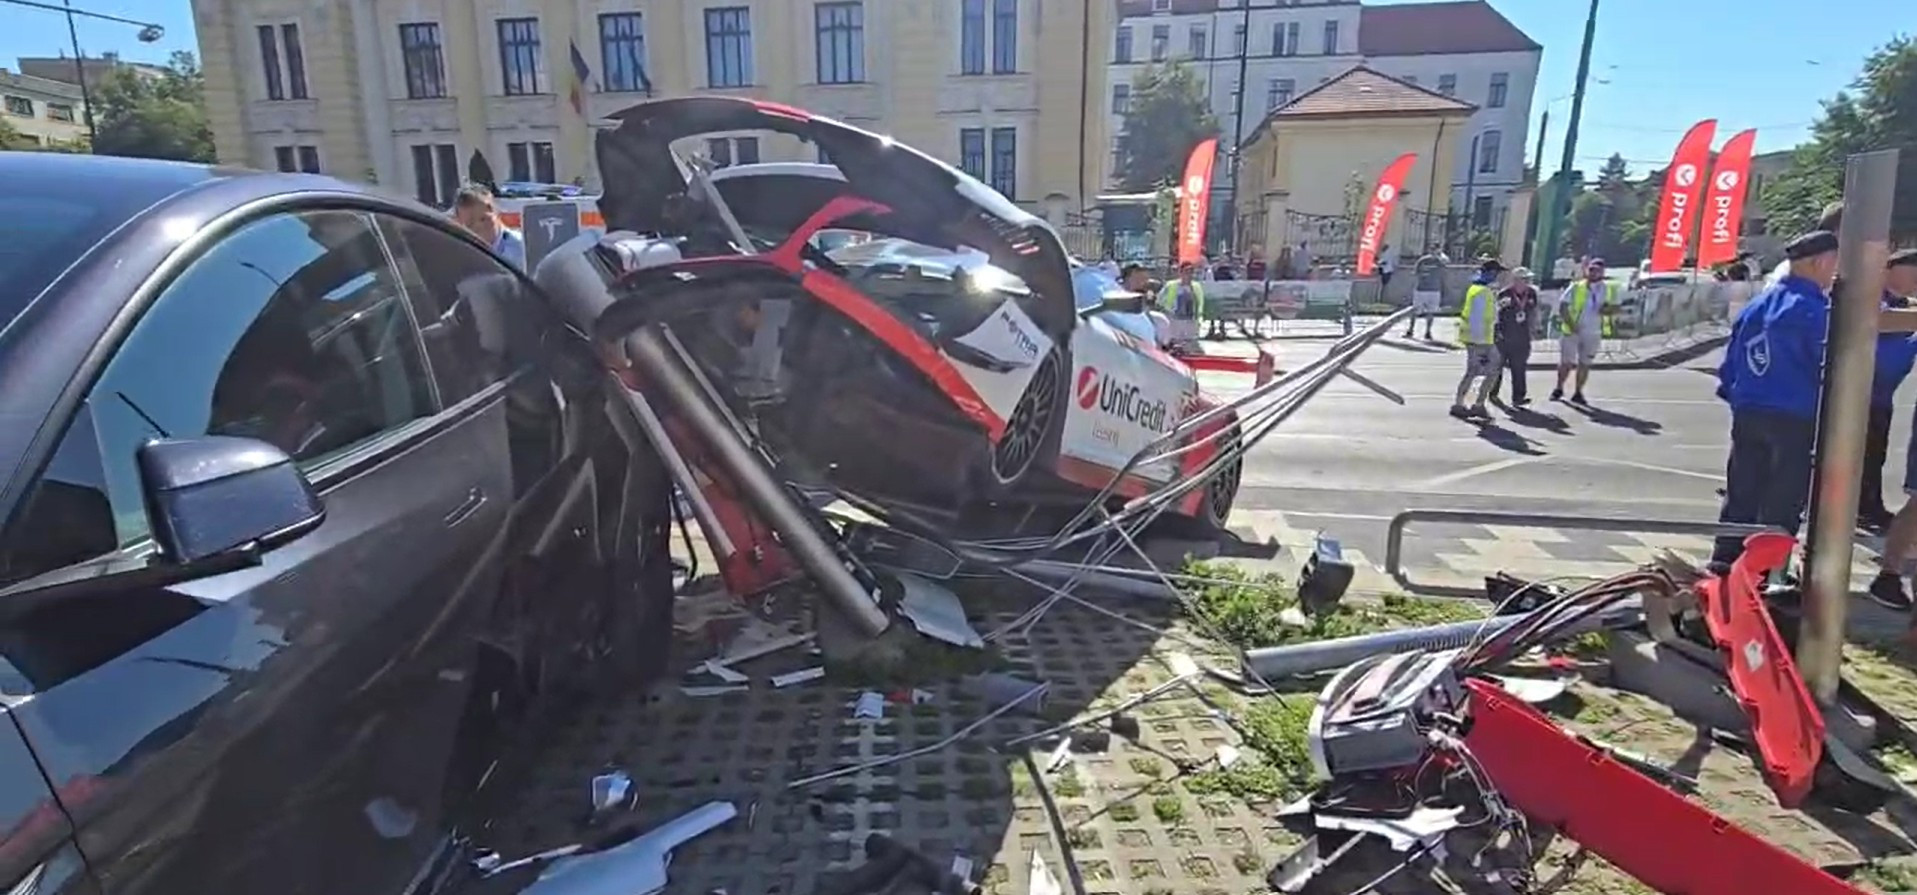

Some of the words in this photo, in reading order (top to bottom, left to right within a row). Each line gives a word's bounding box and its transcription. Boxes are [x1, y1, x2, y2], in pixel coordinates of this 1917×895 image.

[1664, 192, 1688, 248] profi
[1711, 196, 1732, 243] profi
[1100, 373, 1166, 433] UniCredit
